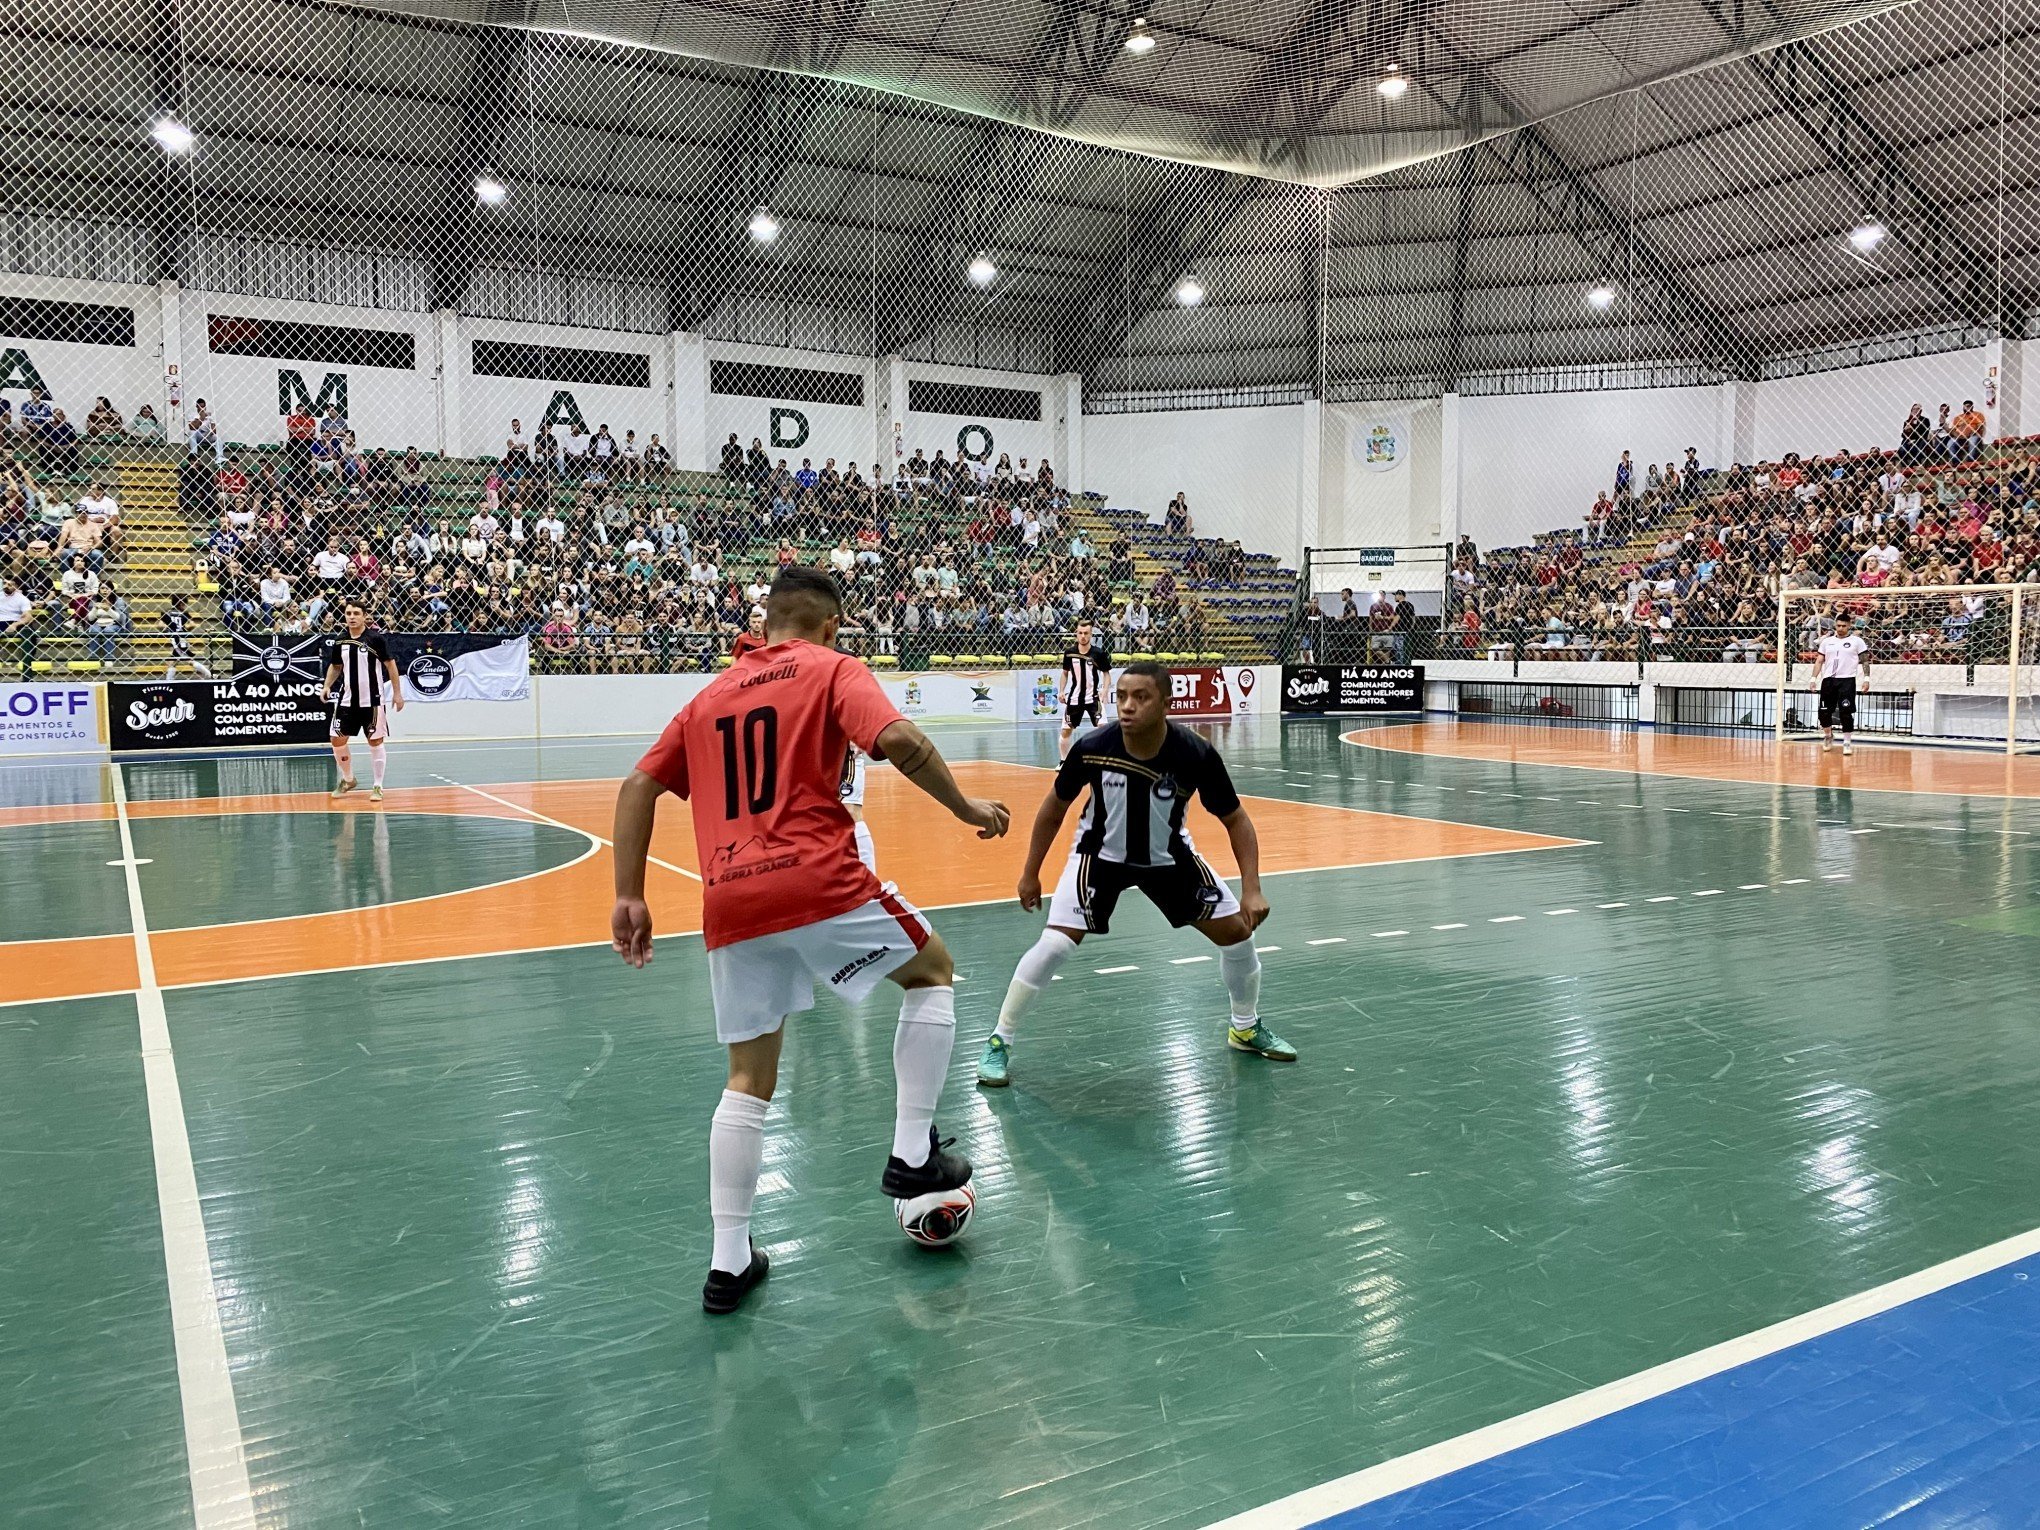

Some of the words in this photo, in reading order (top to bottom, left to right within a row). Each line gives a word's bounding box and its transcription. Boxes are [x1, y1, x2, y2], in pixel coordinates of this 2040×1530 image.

[412, 658, 449, 673] Panelão
[1341, 667, 1359, 679] HÁ
[1361, 669, 1378, 679] 40
[1380, 669, 1414, 679] ANOS
[213, 682, 241, 699] HÁ
[245, 684, 270, 698] 40
[274, 683, 324, 697] ANOS
[1287, 676, 1330, 698] Scur
[1340, 681, 1395, 689] COMBINANDO
[1373, 689, 1414, 697] MELHORES
[1340, 697, 1387, 705] MOMENTOS.
[214, 702, 297, 713] COMBINANDO
[126, 698, 196, 730] Scur
[214, 715, 244, 724] COM
[246, 714, 263, 723] OS
[265, 712, 327, 723] MELHORES
[9, 730, 86, 741] CONSTRUÇÃO
[215, 724, 287, 736] MOMENTOS.
[715, 705, 778, 821] 10
[719, 869, 753, 883] SERRA
